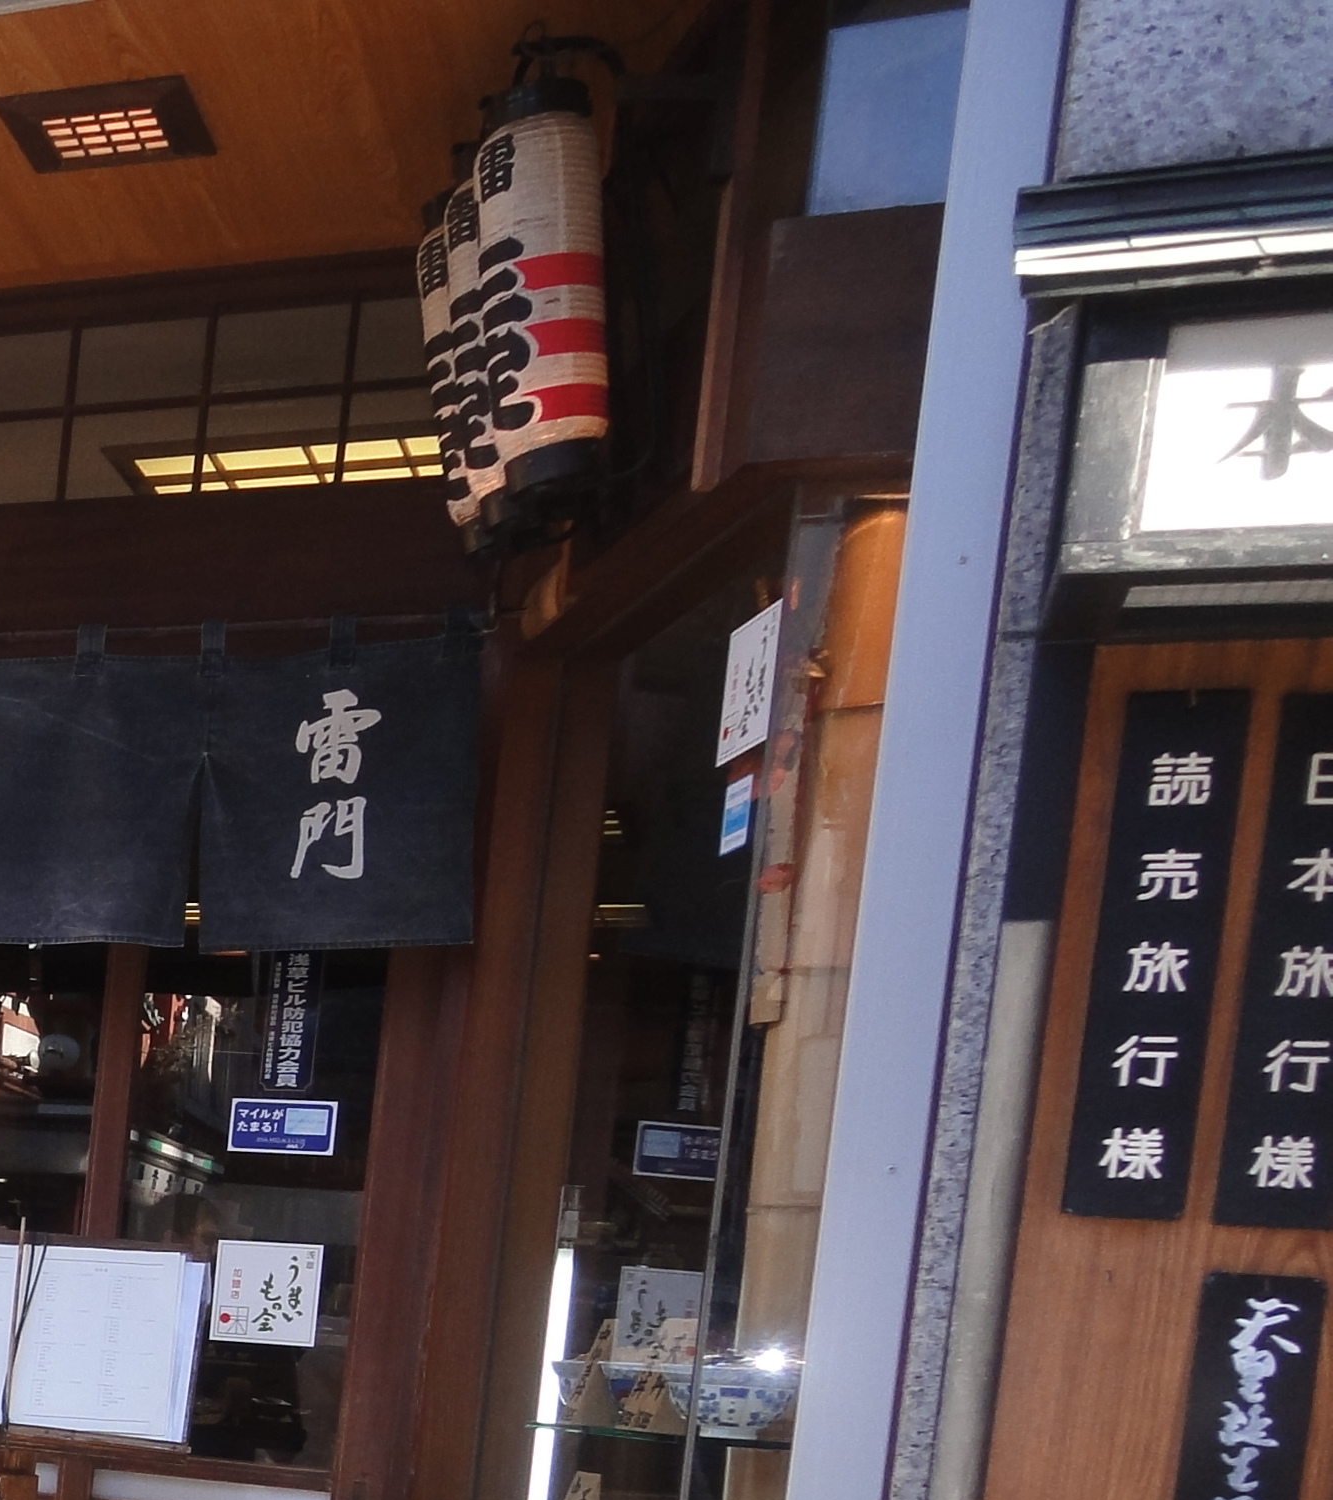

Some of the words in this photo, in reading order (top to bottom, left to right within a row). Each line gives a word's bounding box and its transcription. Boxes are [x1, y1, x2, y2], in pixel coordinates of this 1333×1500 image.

[290, 689, 383, 880] 雷門
[1102, 751, 1214, 1181] 読売旅行様
[275, 953, 310, 1088] 浅草ビル防犯協力会員
[237, 1108, 285, 1121] マイルが
[251, 1272, 282, 1332] もの会
[281, 1255, 303, 1323] うまい
